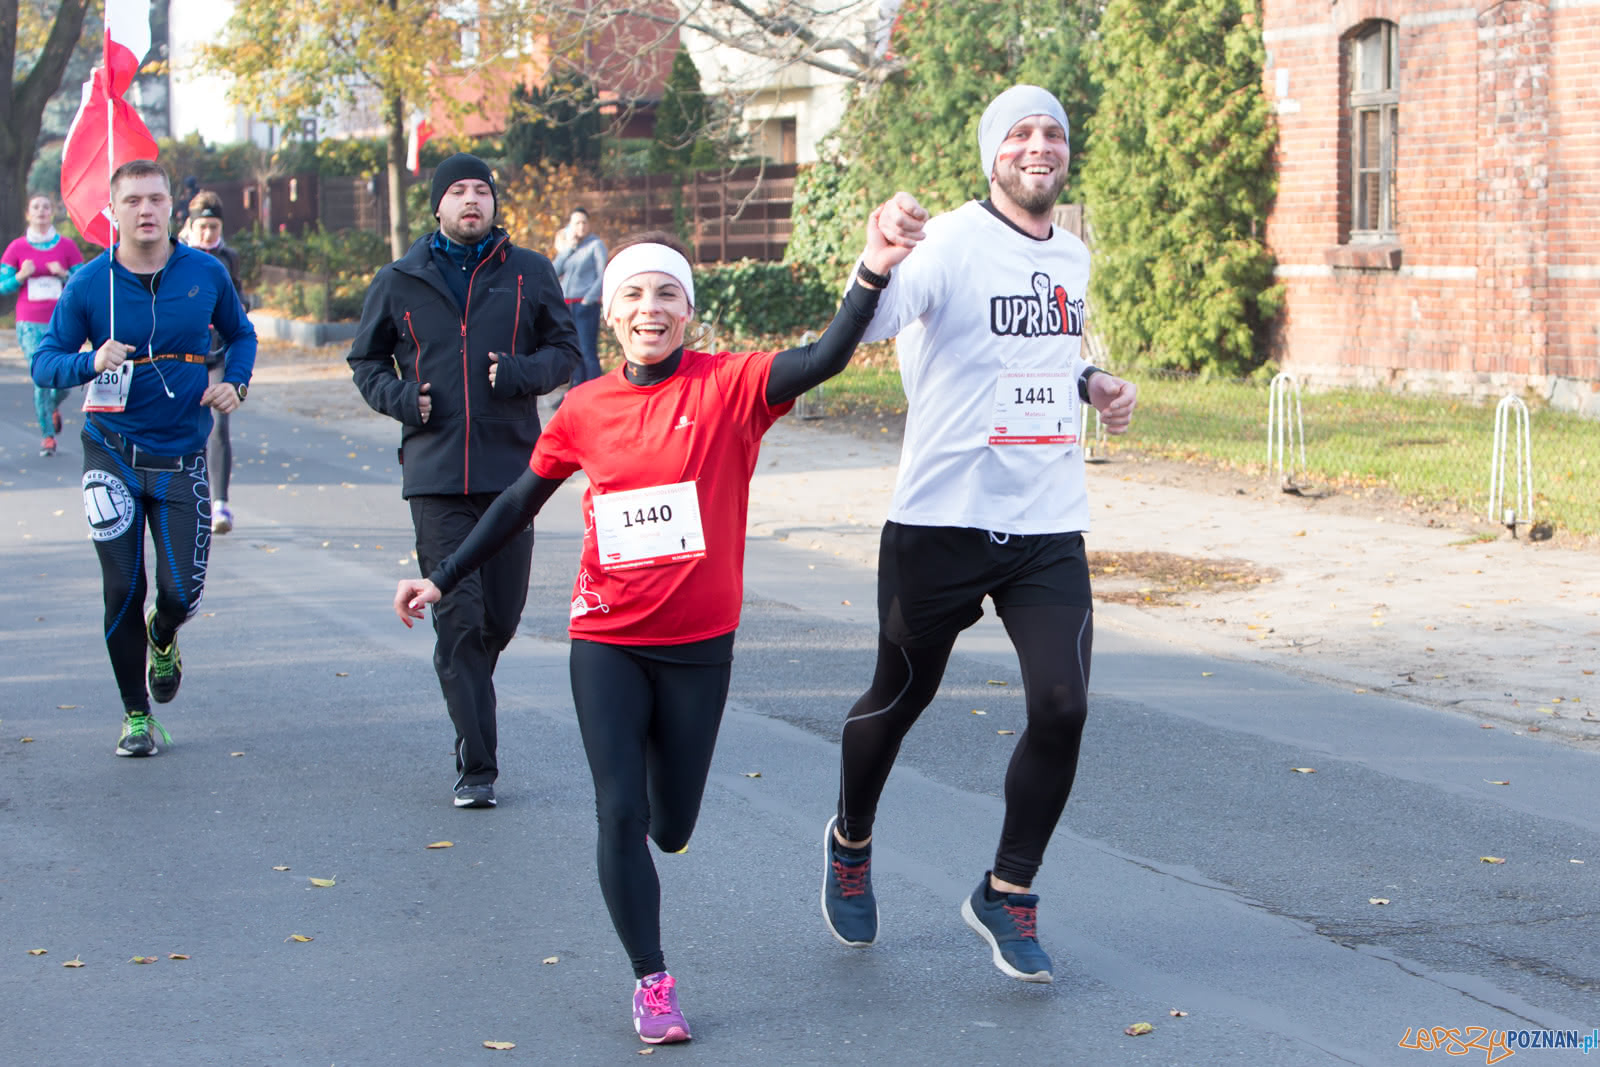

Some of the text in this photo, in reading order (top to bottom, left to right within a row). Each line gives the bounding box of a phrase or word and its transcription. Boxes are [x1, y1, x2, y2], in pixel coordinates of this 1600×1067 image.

[94, 373, 119, 385] 230
[1015, 387, 1055, 404] 1441
[185, 449, 212, 593] WESTCOAS
[622, 504, 672, 528] 1440
